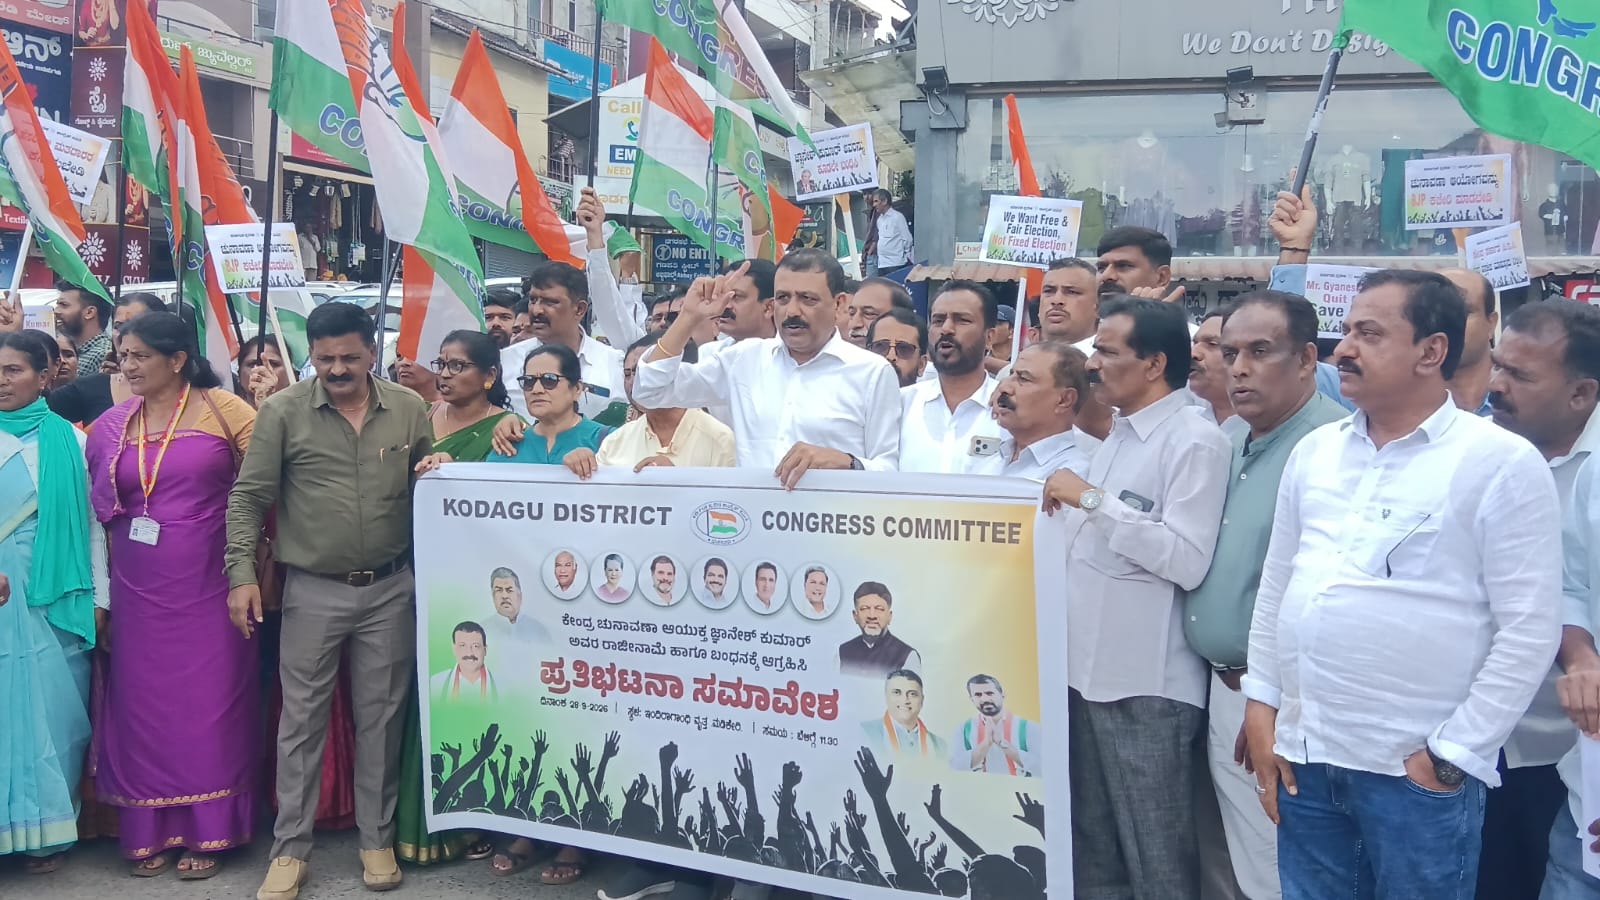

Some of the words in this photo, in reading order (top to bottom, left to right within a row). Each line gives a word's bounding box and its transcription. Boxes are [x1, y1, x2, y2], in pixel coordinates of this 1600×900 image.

[1182, 31, 1223, 55] We
[1230, 29, 1303, 54] Don't
[1311, 28, 1394, 57] Dsig
[607, 100, 641, 113] Call
[319, 103, 368, 157] CO
[1410, 193, 1426, 207] BJP
[1003, 211, 1016, 222] We
[1018, 212, 1038, 224] Want
[1040, 214, 1059, 226] Free
[1062, 216, 1069, 227] &
[1006, 223, 1022, 235] Fair
[1024, 225, 1060, 240] Election,
[992, 234, 1006, 245] Not
[1008, 235, 1029, 248] Fixed
[1032, 237, 1066, 251] Election
[671, 247, 687, 259] NO
[688, 247, 720, 260] ENT
[1306, 280, 1320, 290] Mr.
[1323, 294, 1347, 304] Quit
[1314, 303, 1344, 317] ave
[442, 498, 544, 521] KODAGU
[553, 503, 672, 526] DISTRICT
[761, 510, 876, 537] CONGRESS
[882, 516, 1022, 545] COMMITTEE
[562, 613, 595, 632] ಕೇಂದ್ರ
[597, 619, 658, 634] ಚುನಾವಣಾ
[661, 623, 708, 643] ಆಯುಕ್ತ
[710, 626, 757, 644] ಜ್ಞಾನೇಶ್
[759, 632, 812, 648] ಕುಮಾರ್
[568, 636, 599, 649] ಅವರ
[602, 639, 666, 656] ರಾಜೀನಾಮೆ
[670, 645, 708, 660] ಹಾಗೂ
[710, 649, 760, 671] ಬಂಧನಕ್ಕೆ
[762, 655, 808, 672] ಆಗ್ರಹಿಸಿ
[540, 656, 684, 699] ಪ್ರತಿಭಟನಾ
[692, 672, 840, 721] ಸಮಾವೇಶ
